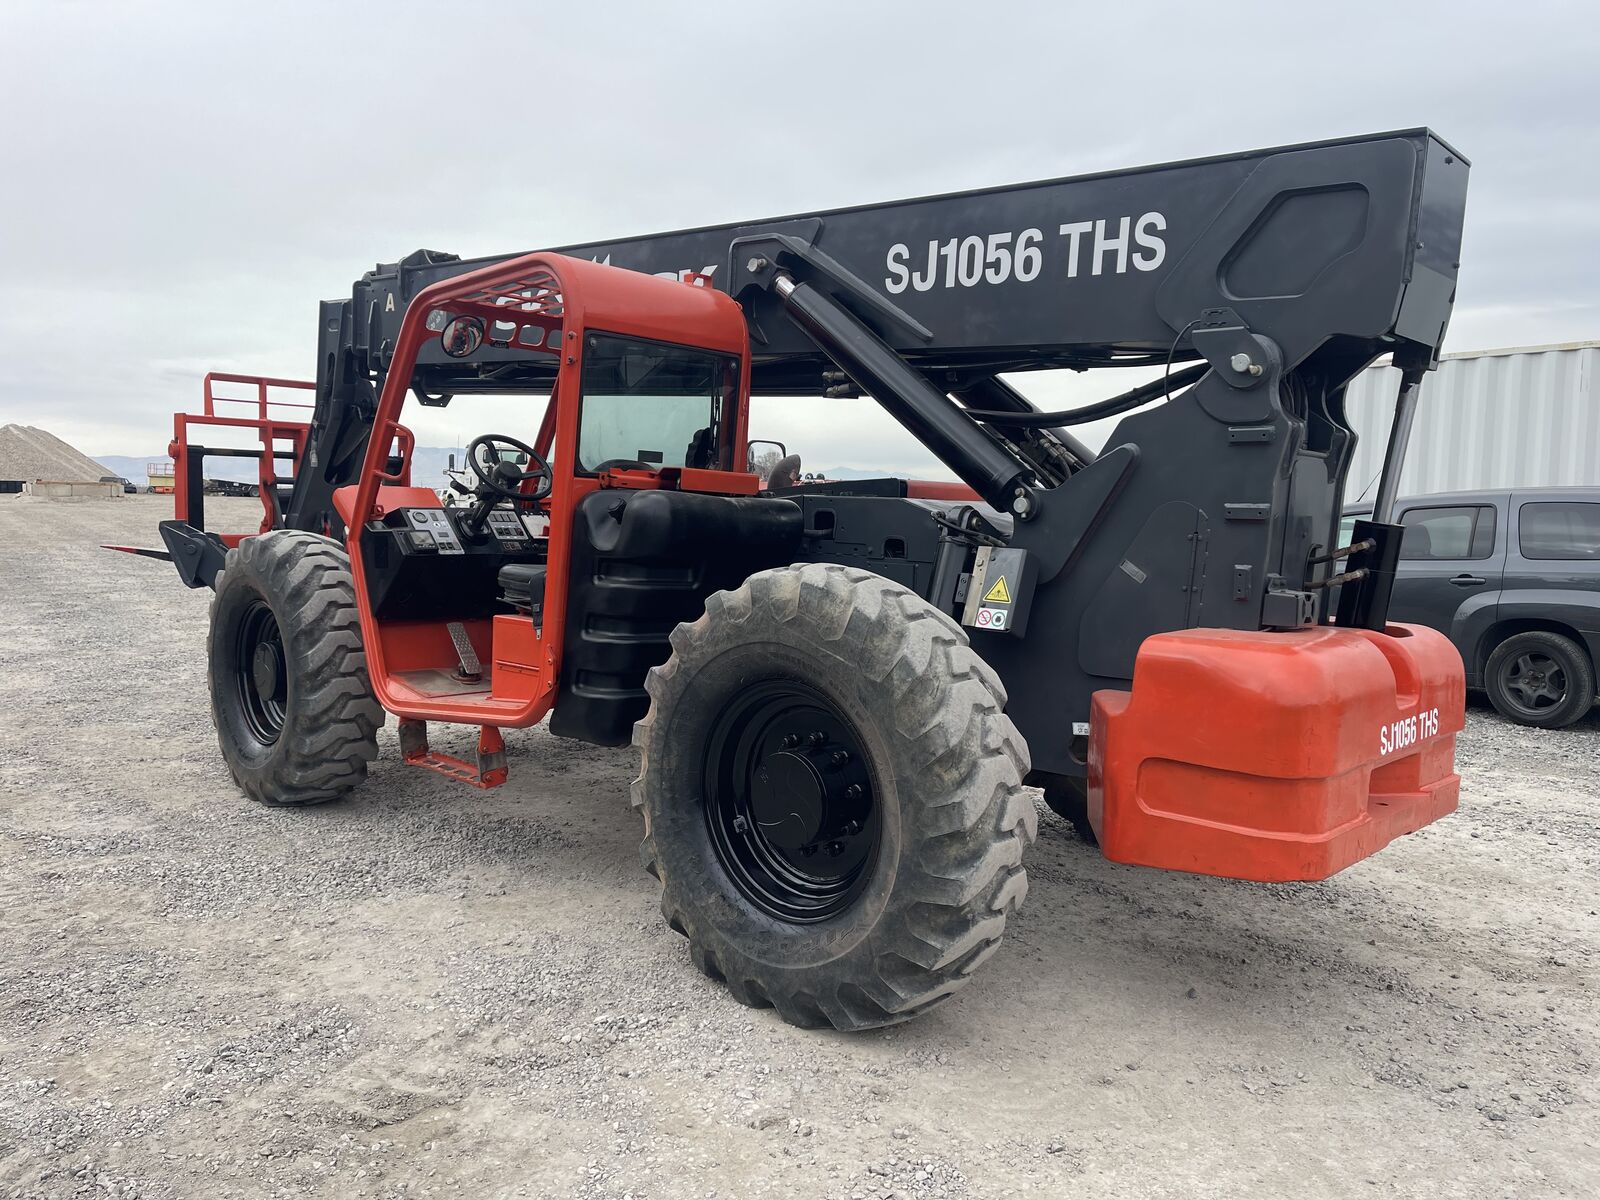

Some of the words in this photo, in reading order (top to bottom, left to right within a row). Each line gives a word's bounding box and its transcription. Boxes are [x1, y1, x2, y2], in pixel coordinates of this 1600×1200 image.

[885, 228, 1044, 294] SJ1056
[1059, 211, 1167, 278] THS
[385, 292, 395, 312] A
[1380, 715, 1417, 756] SJ1056
[1419, 707, 1439, 740] THS
